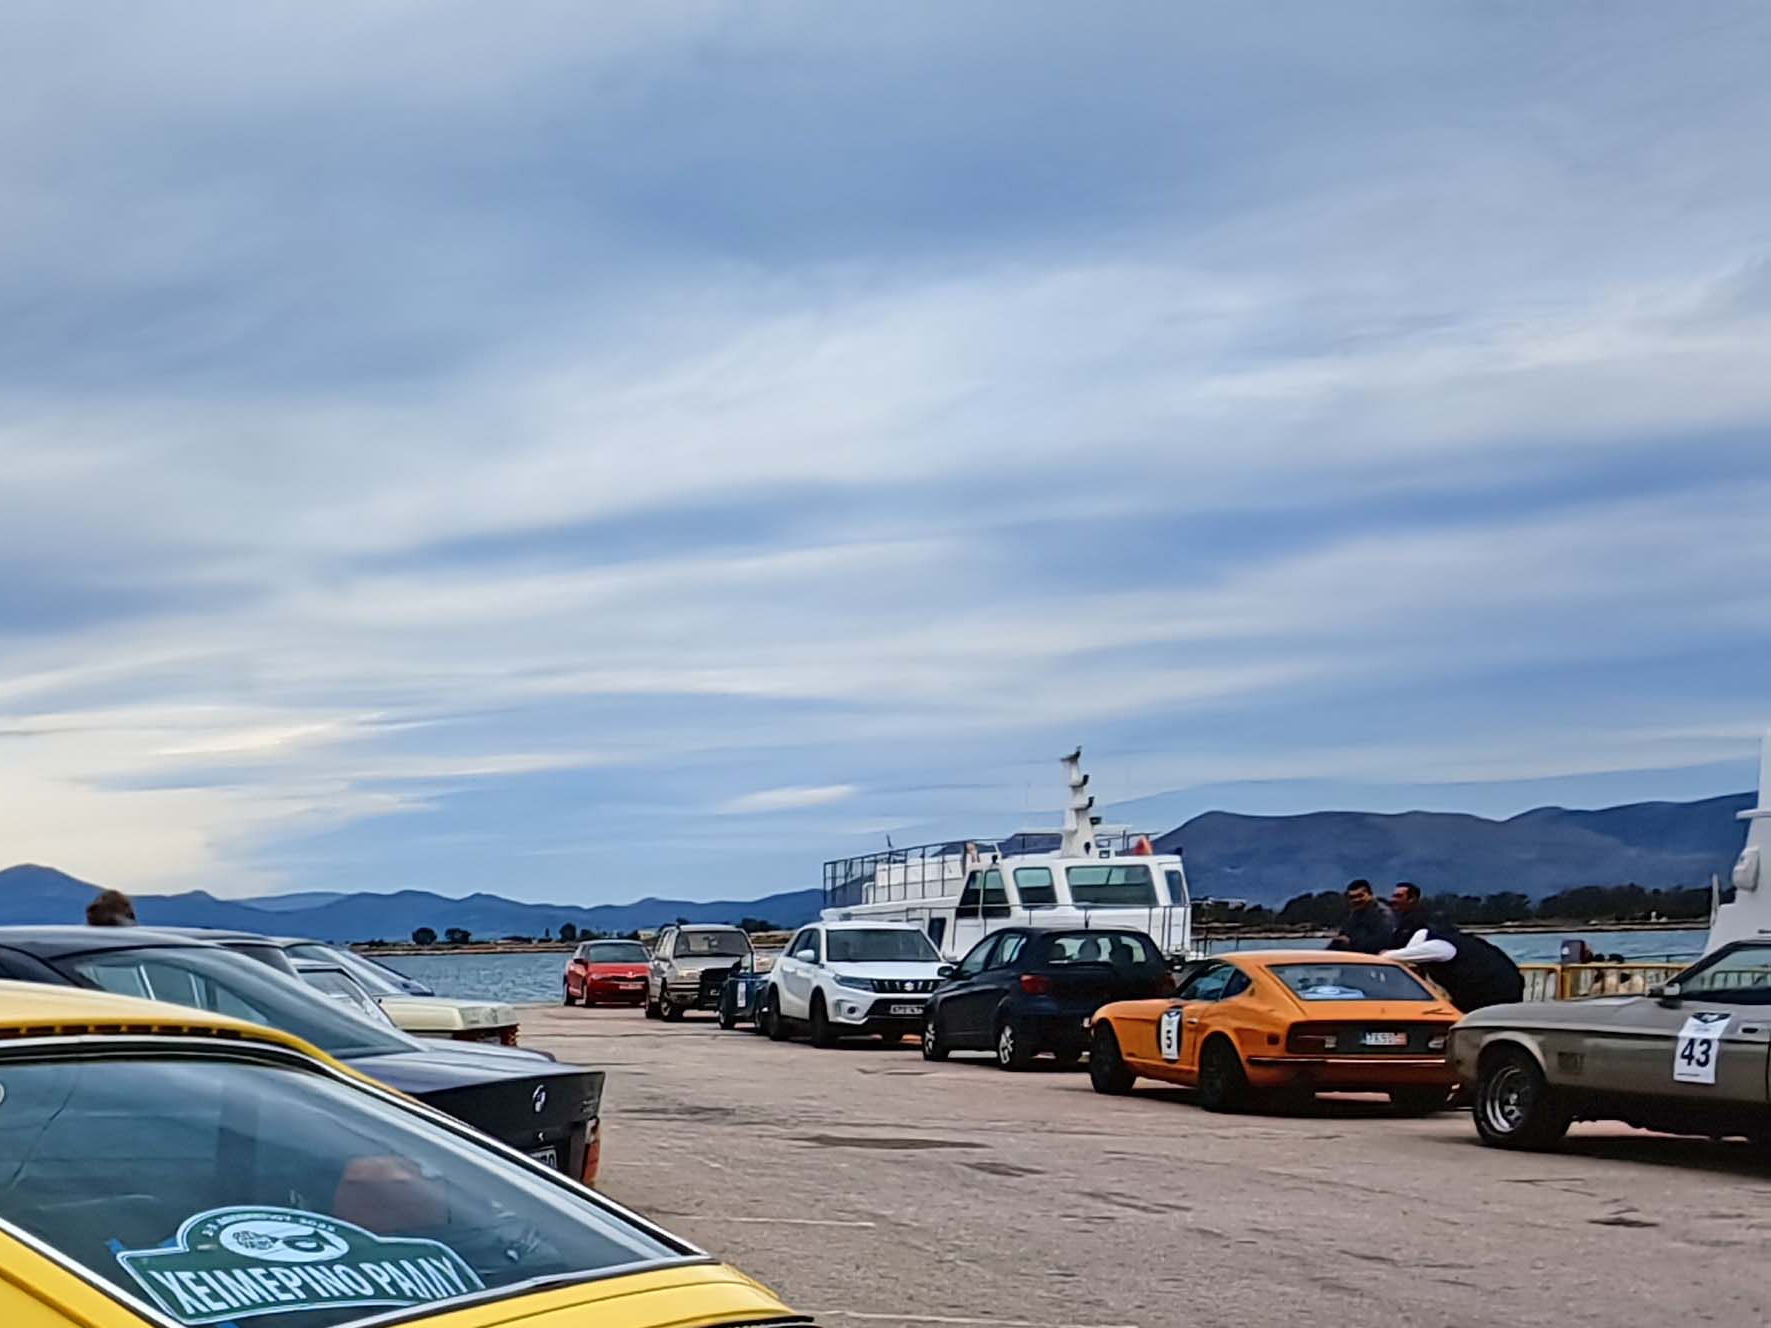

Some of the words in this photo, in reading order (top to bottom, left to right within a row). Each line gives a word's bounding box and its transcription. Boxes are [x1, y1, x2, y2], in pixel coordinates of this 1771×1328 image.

[1165, 1029, 1173, 1049] 5
[1680, 1038, 1712, 1068] 43
[148, 1262, 376, 1315] ΧΕΙΜΕΡΙΝΟ
[368, 1255, 469, 1300] ΡΑΛΛΥ
